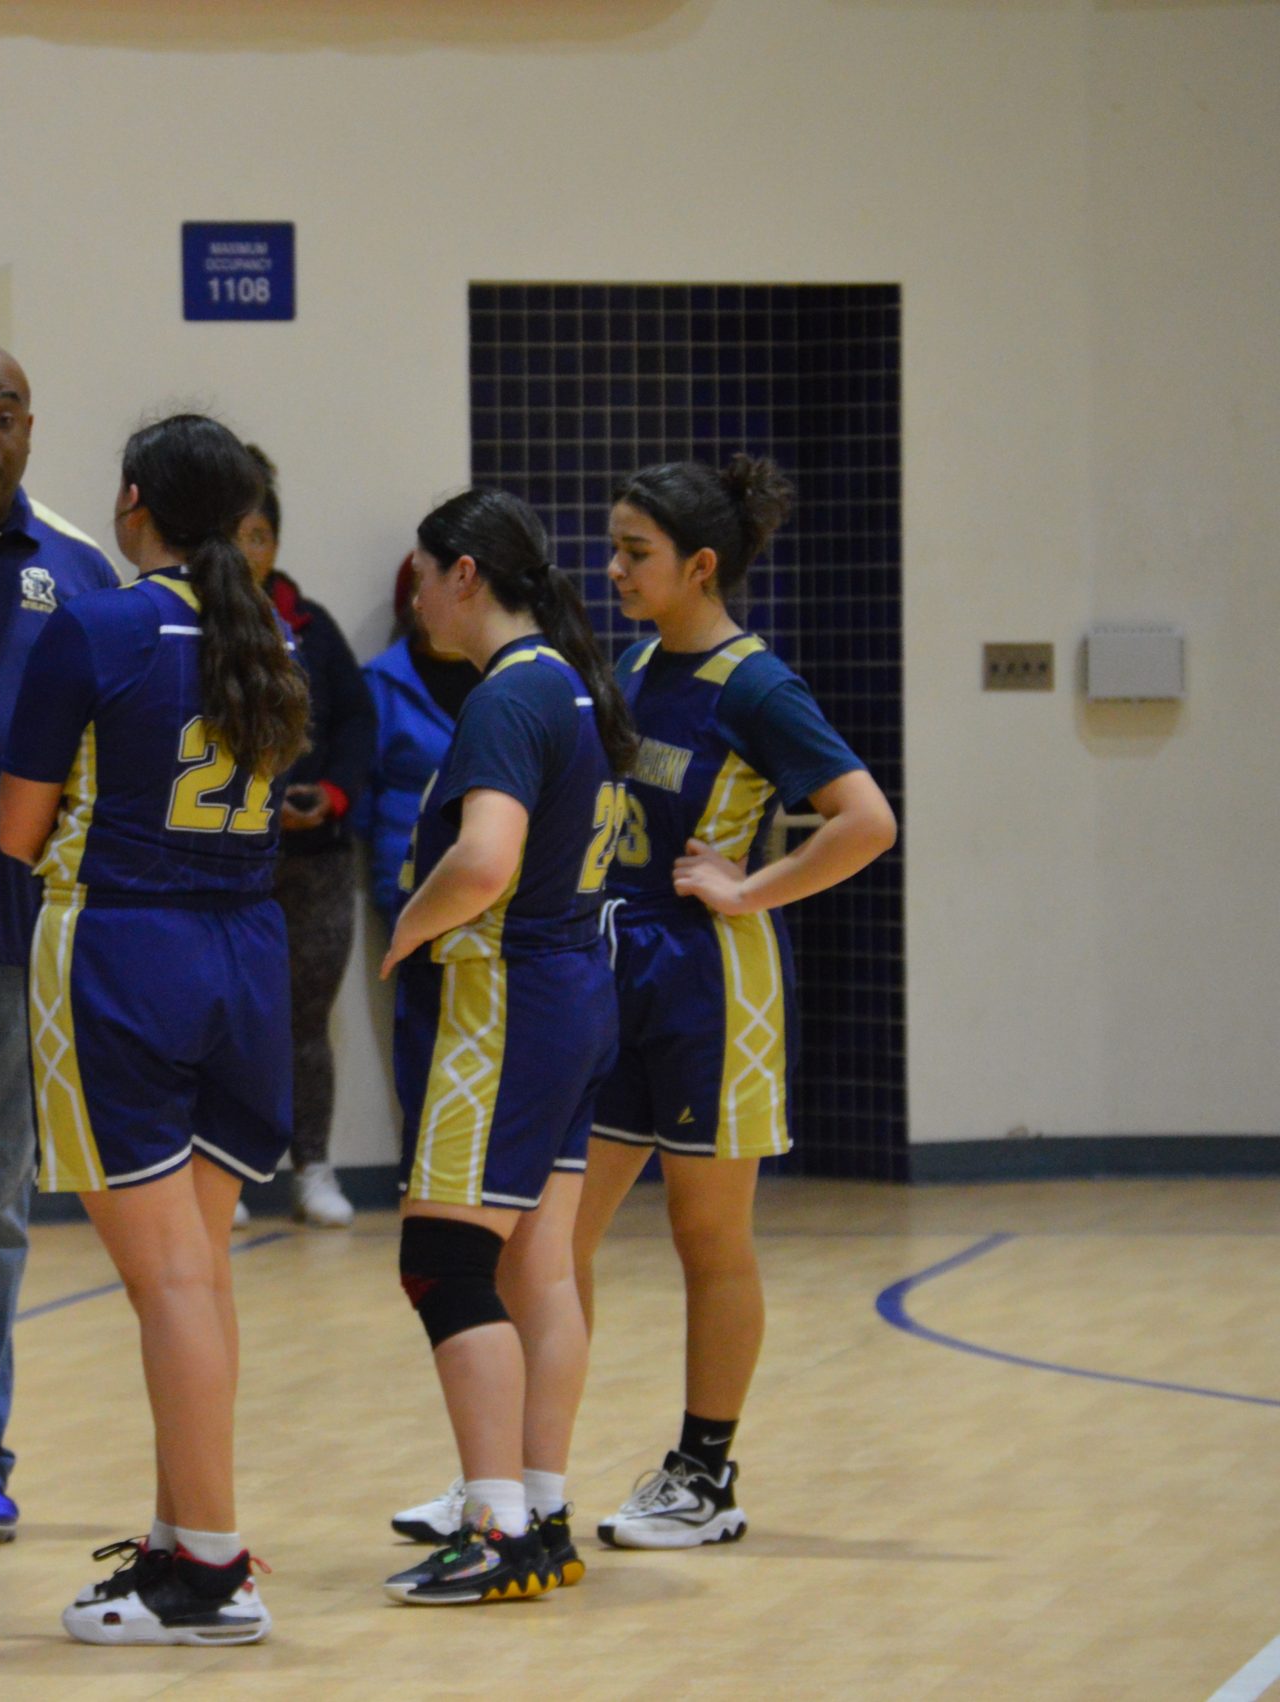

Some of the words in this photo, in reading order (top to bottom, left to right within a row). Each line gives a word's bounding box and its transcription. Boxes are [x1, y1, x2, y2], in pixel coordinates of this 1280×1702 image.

[210, 242, 268, 254] MAXIMUM
[208, 277, 270, 303] 1108
[165, 714, 275, 834] 21
